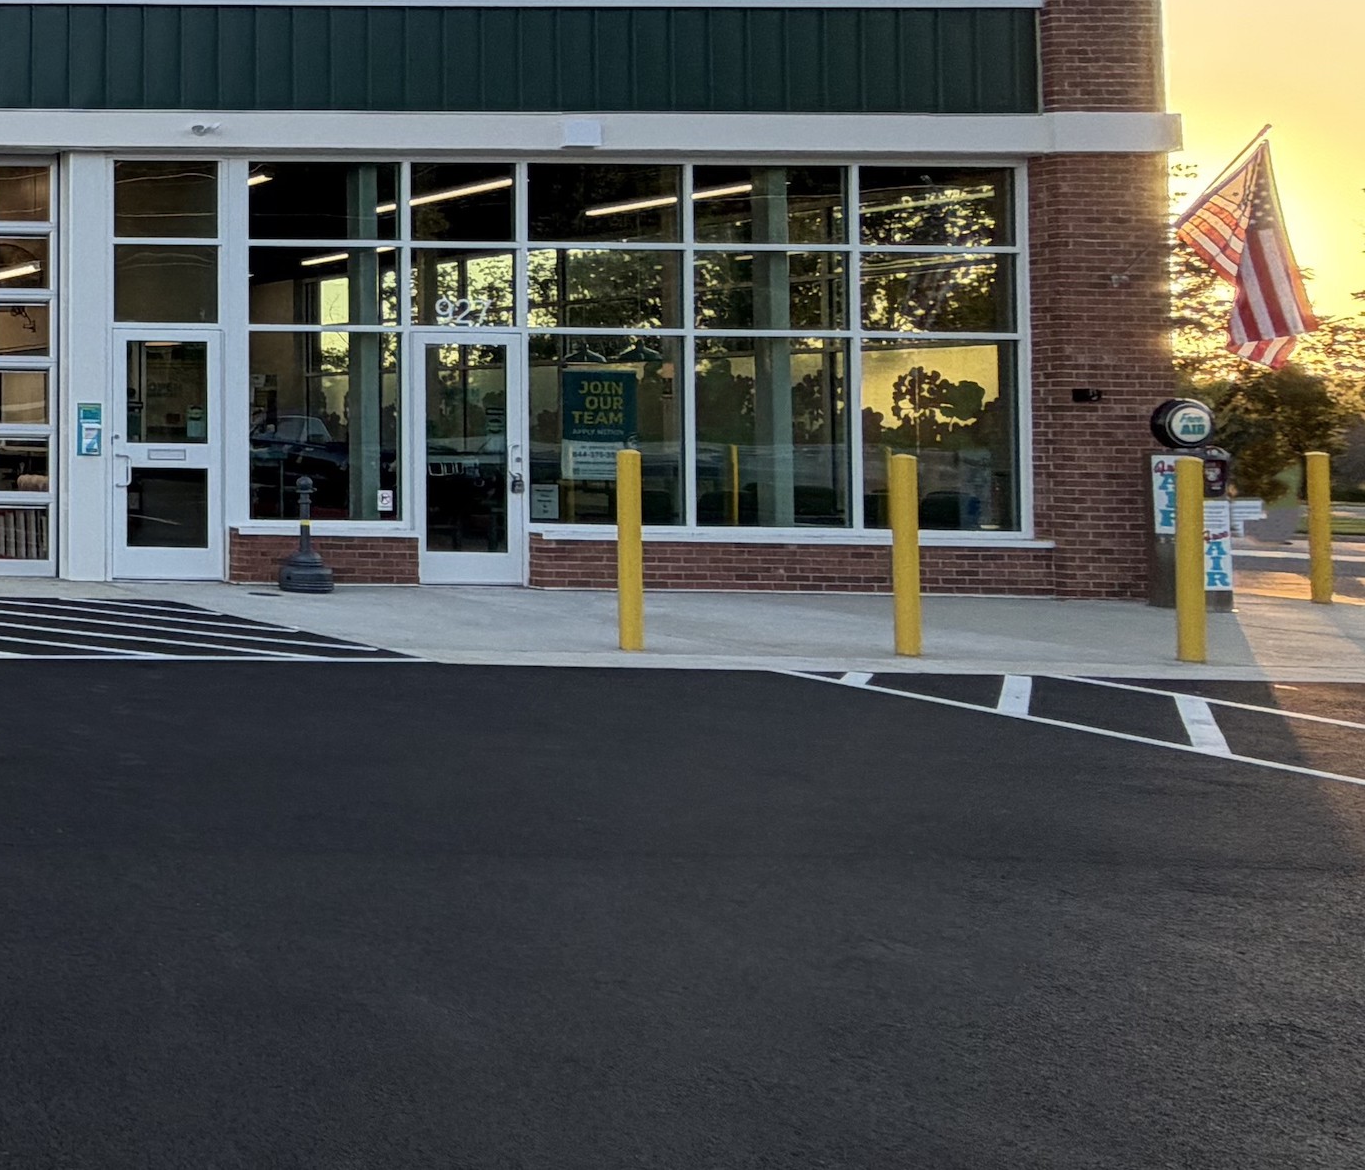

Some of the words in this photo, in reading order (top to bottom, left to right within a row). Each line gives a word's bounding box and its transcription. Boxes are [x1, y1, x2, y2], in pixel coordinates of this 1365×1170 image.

[435, 298, 491, 324] 927
[578, 381, 623, 395] JOIN
[585, 396, 623, 409] OUR
[572, 411, 623, 424] TEAM
[1180, 413, 1203, 423] Free
[1180, 424, 1205, 435] AIR
[1205, 541, 1230, 587] AIR
